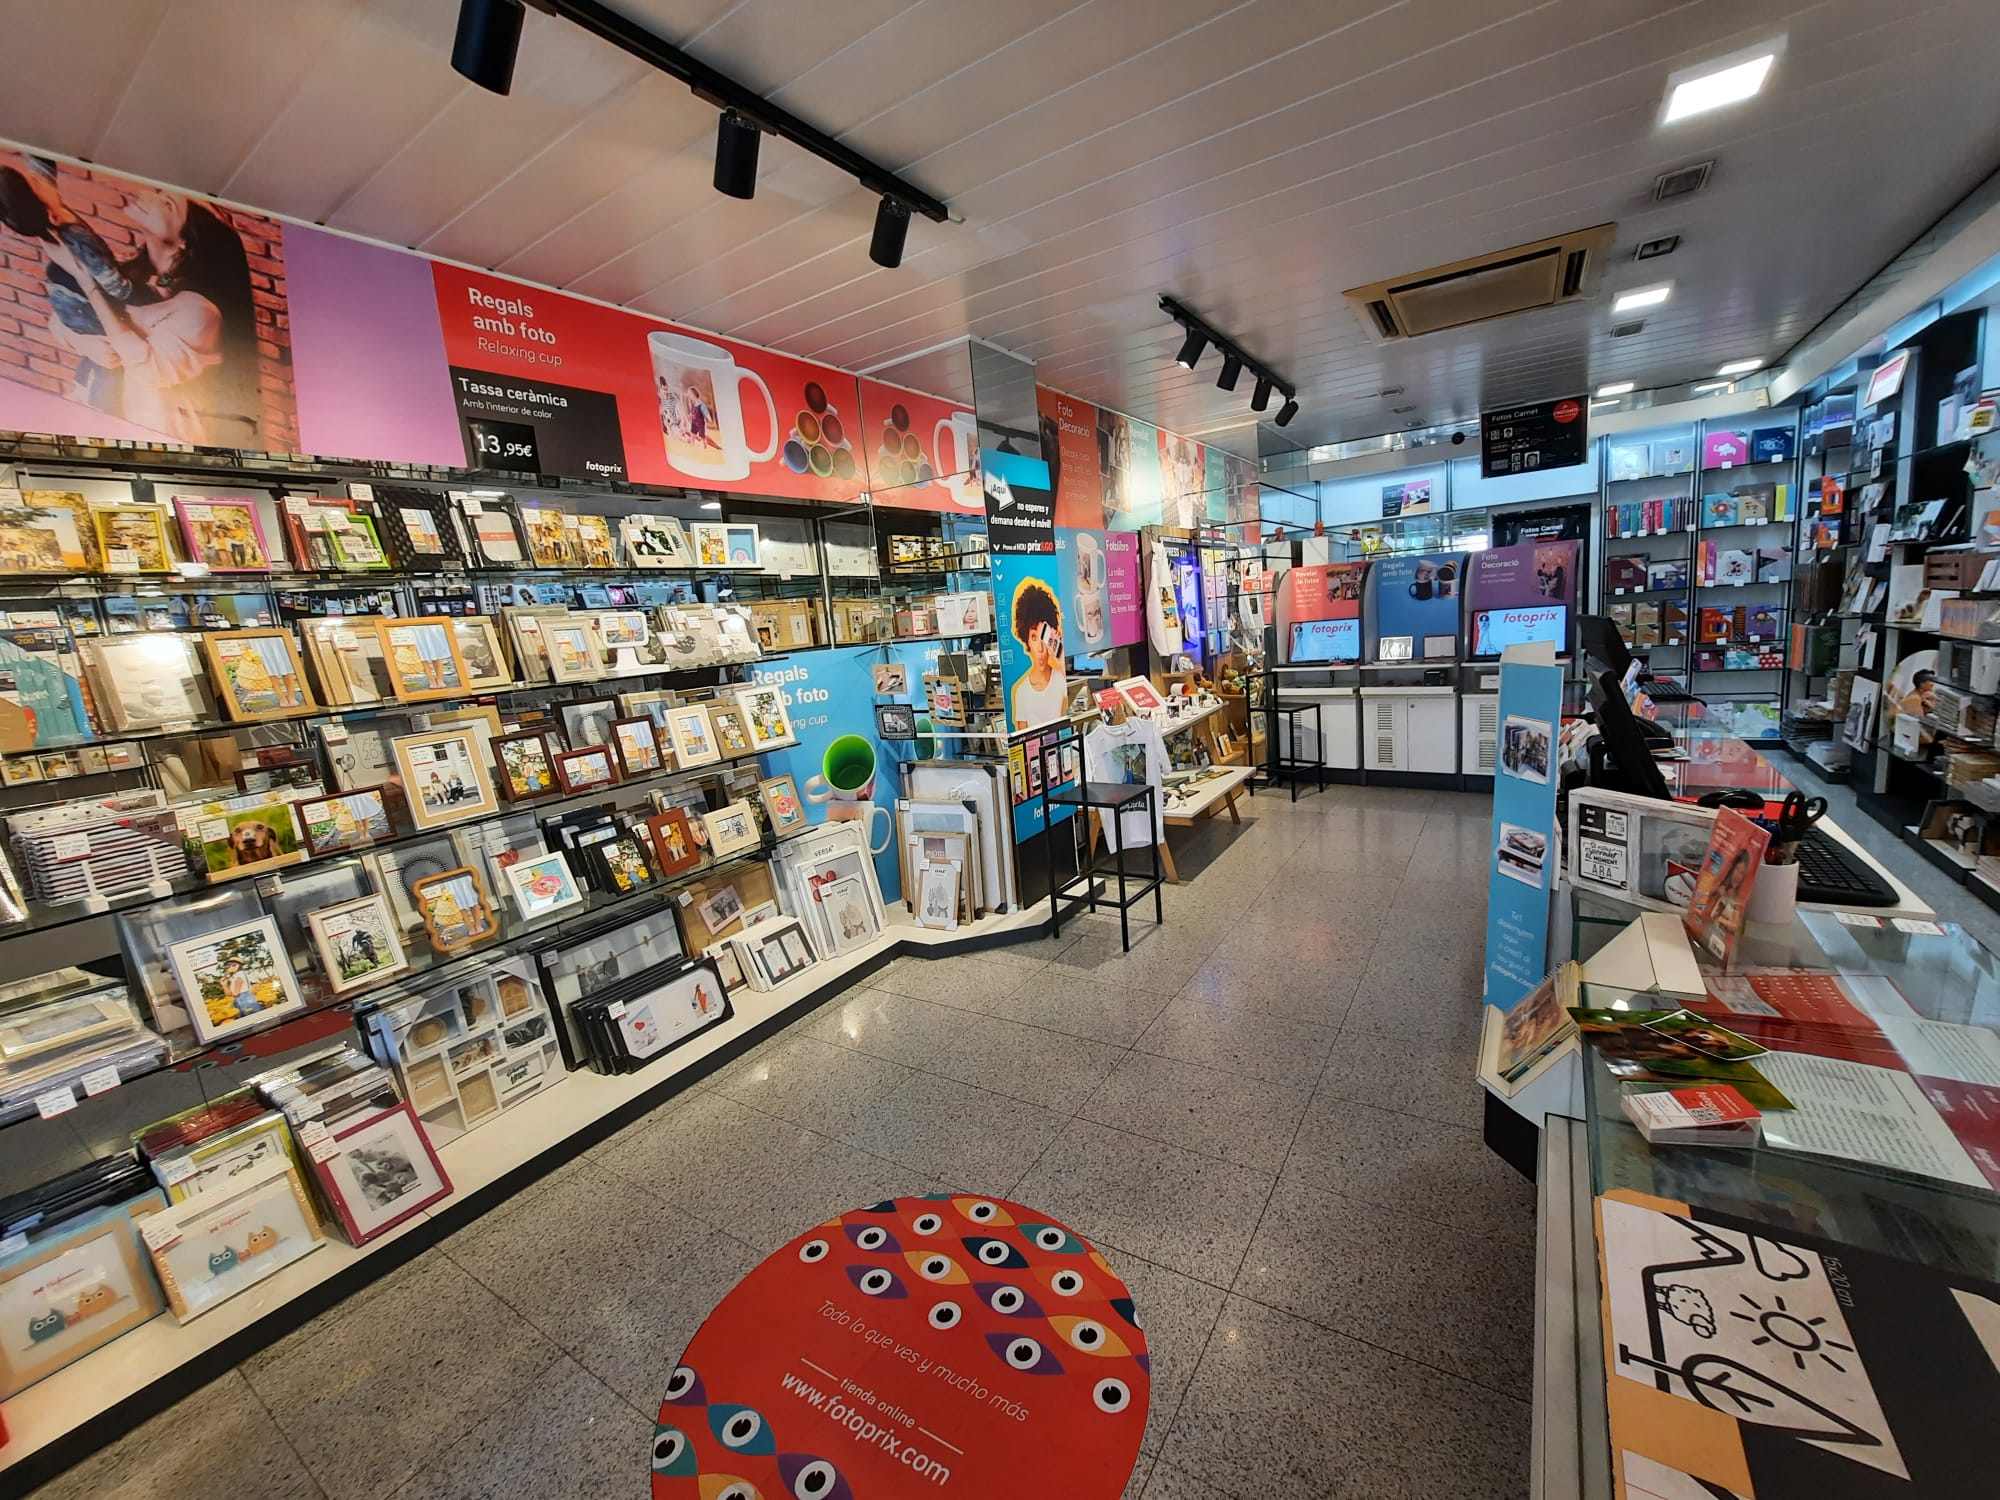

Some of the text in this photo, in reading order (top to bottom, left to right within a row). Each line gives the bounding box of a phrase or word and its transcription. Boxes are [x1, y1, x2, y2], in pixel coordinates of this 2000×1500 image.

[468, 286, 534, 318] Regals
[473, 315, 556, 345] amb foto
[478, 336, 563, 368] Relaxing cup
[458, 377, 568, 408] Tassa ceràmica
[463, 398, 485, 410] Amb
[521, 405, 532, 416] de
[1058, 402, 1073, 418] Foto
[1492, 408, 1538, 422] Fotos Carnet
[1059, 417, 1090, 438] Decoració
[586, 460, 622, 474] fotoprix
[1014, 516, 1030, 528] desde
[1520, 526, 1540, 535] Fotos
[1540, 524, 1564, 532] Carnet
[1481, 552, 1498, 560] Foto
[1481, 559, 1519, 569] Decoració
[1503, 610, 1558, 624] fotoprix
[1312, 622, 1352, 634] fotoprix
[751, 665, 809, 687] Regals
[796, 688, 829, 705] foto
[814, 846, 832, 857] VERSA
[1592, 864, 1612, 878] ARA
[1836, 1288, 1856, 1307] cm
[817, 1300, 1030, 1422] Todo lo que ves y mucho más
[840, 1377, 916, 1429] tienda online
[780, 1372, 952, 1486] www.fotoprix.com
